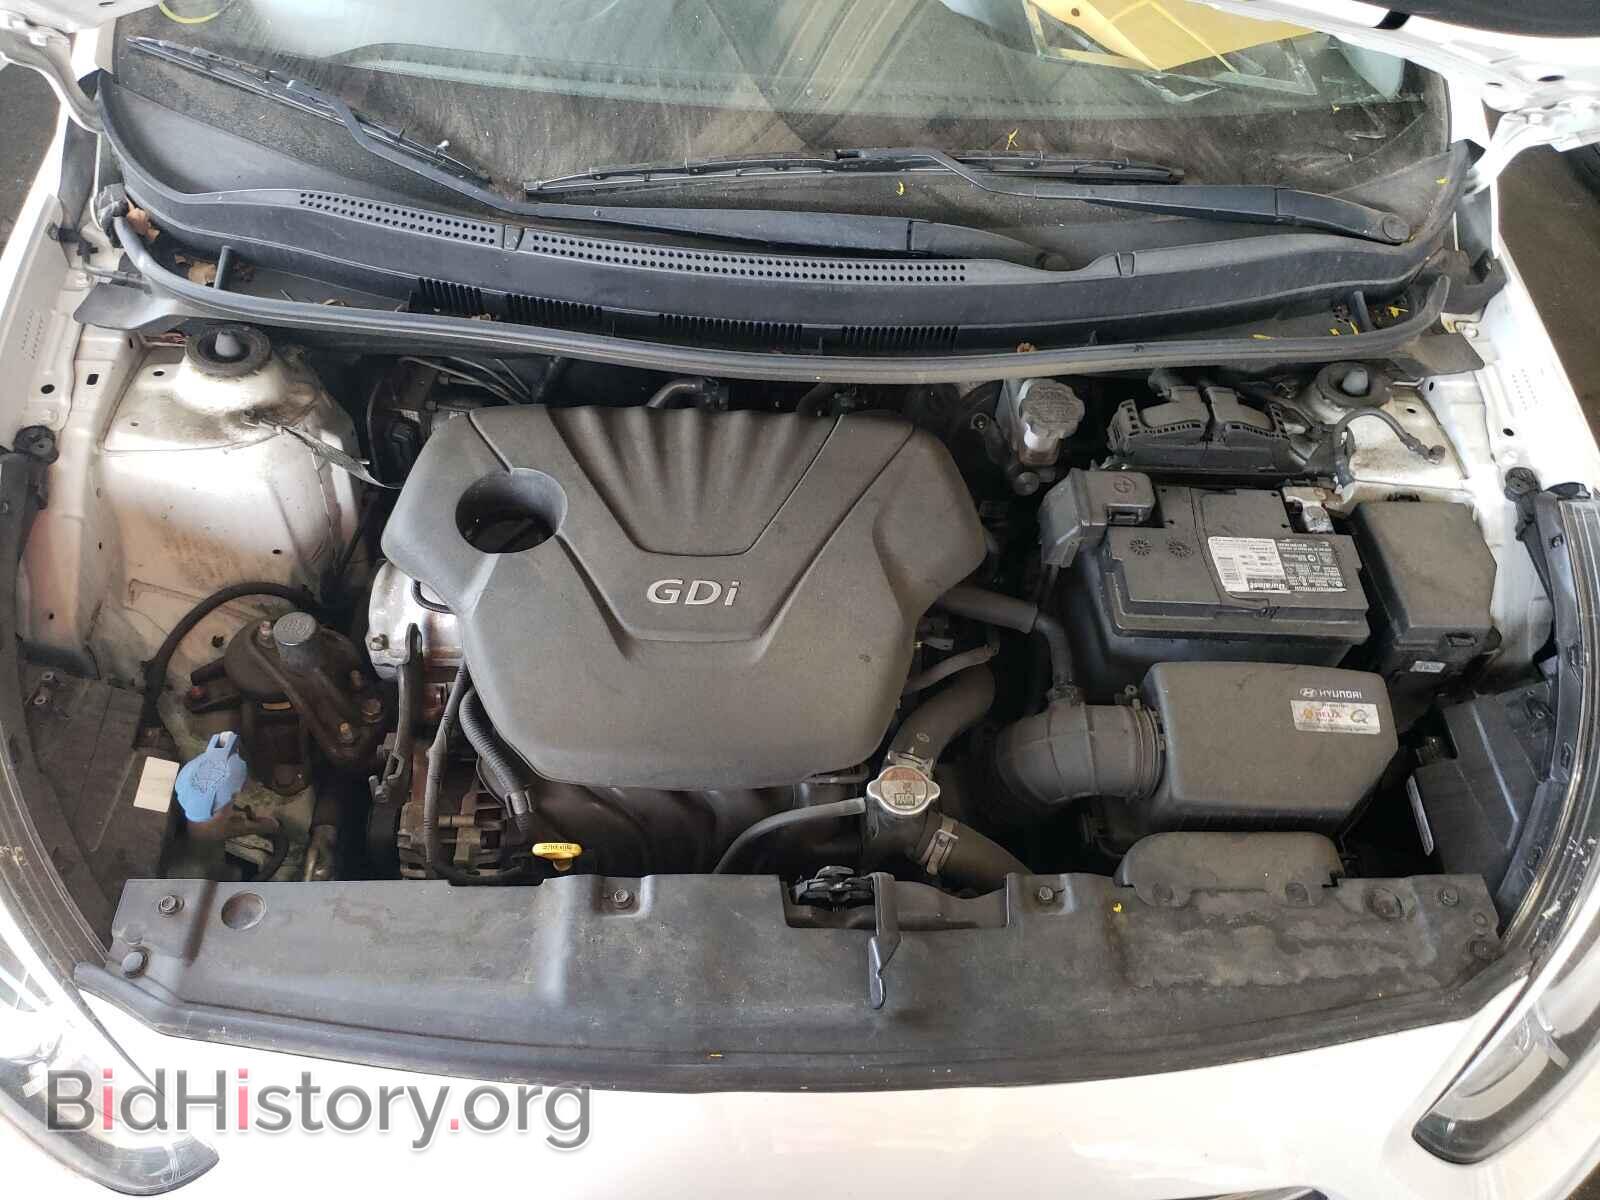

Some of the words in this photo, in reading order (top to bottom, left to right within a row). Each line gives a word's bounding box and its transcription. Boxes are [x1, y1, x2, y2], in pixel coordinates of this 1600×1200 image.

[1249, 582, 1286, 590] Duralast
[646, 579, 740, 606] GDi
[1319, 688, 1362, 699] HYUNDAI
